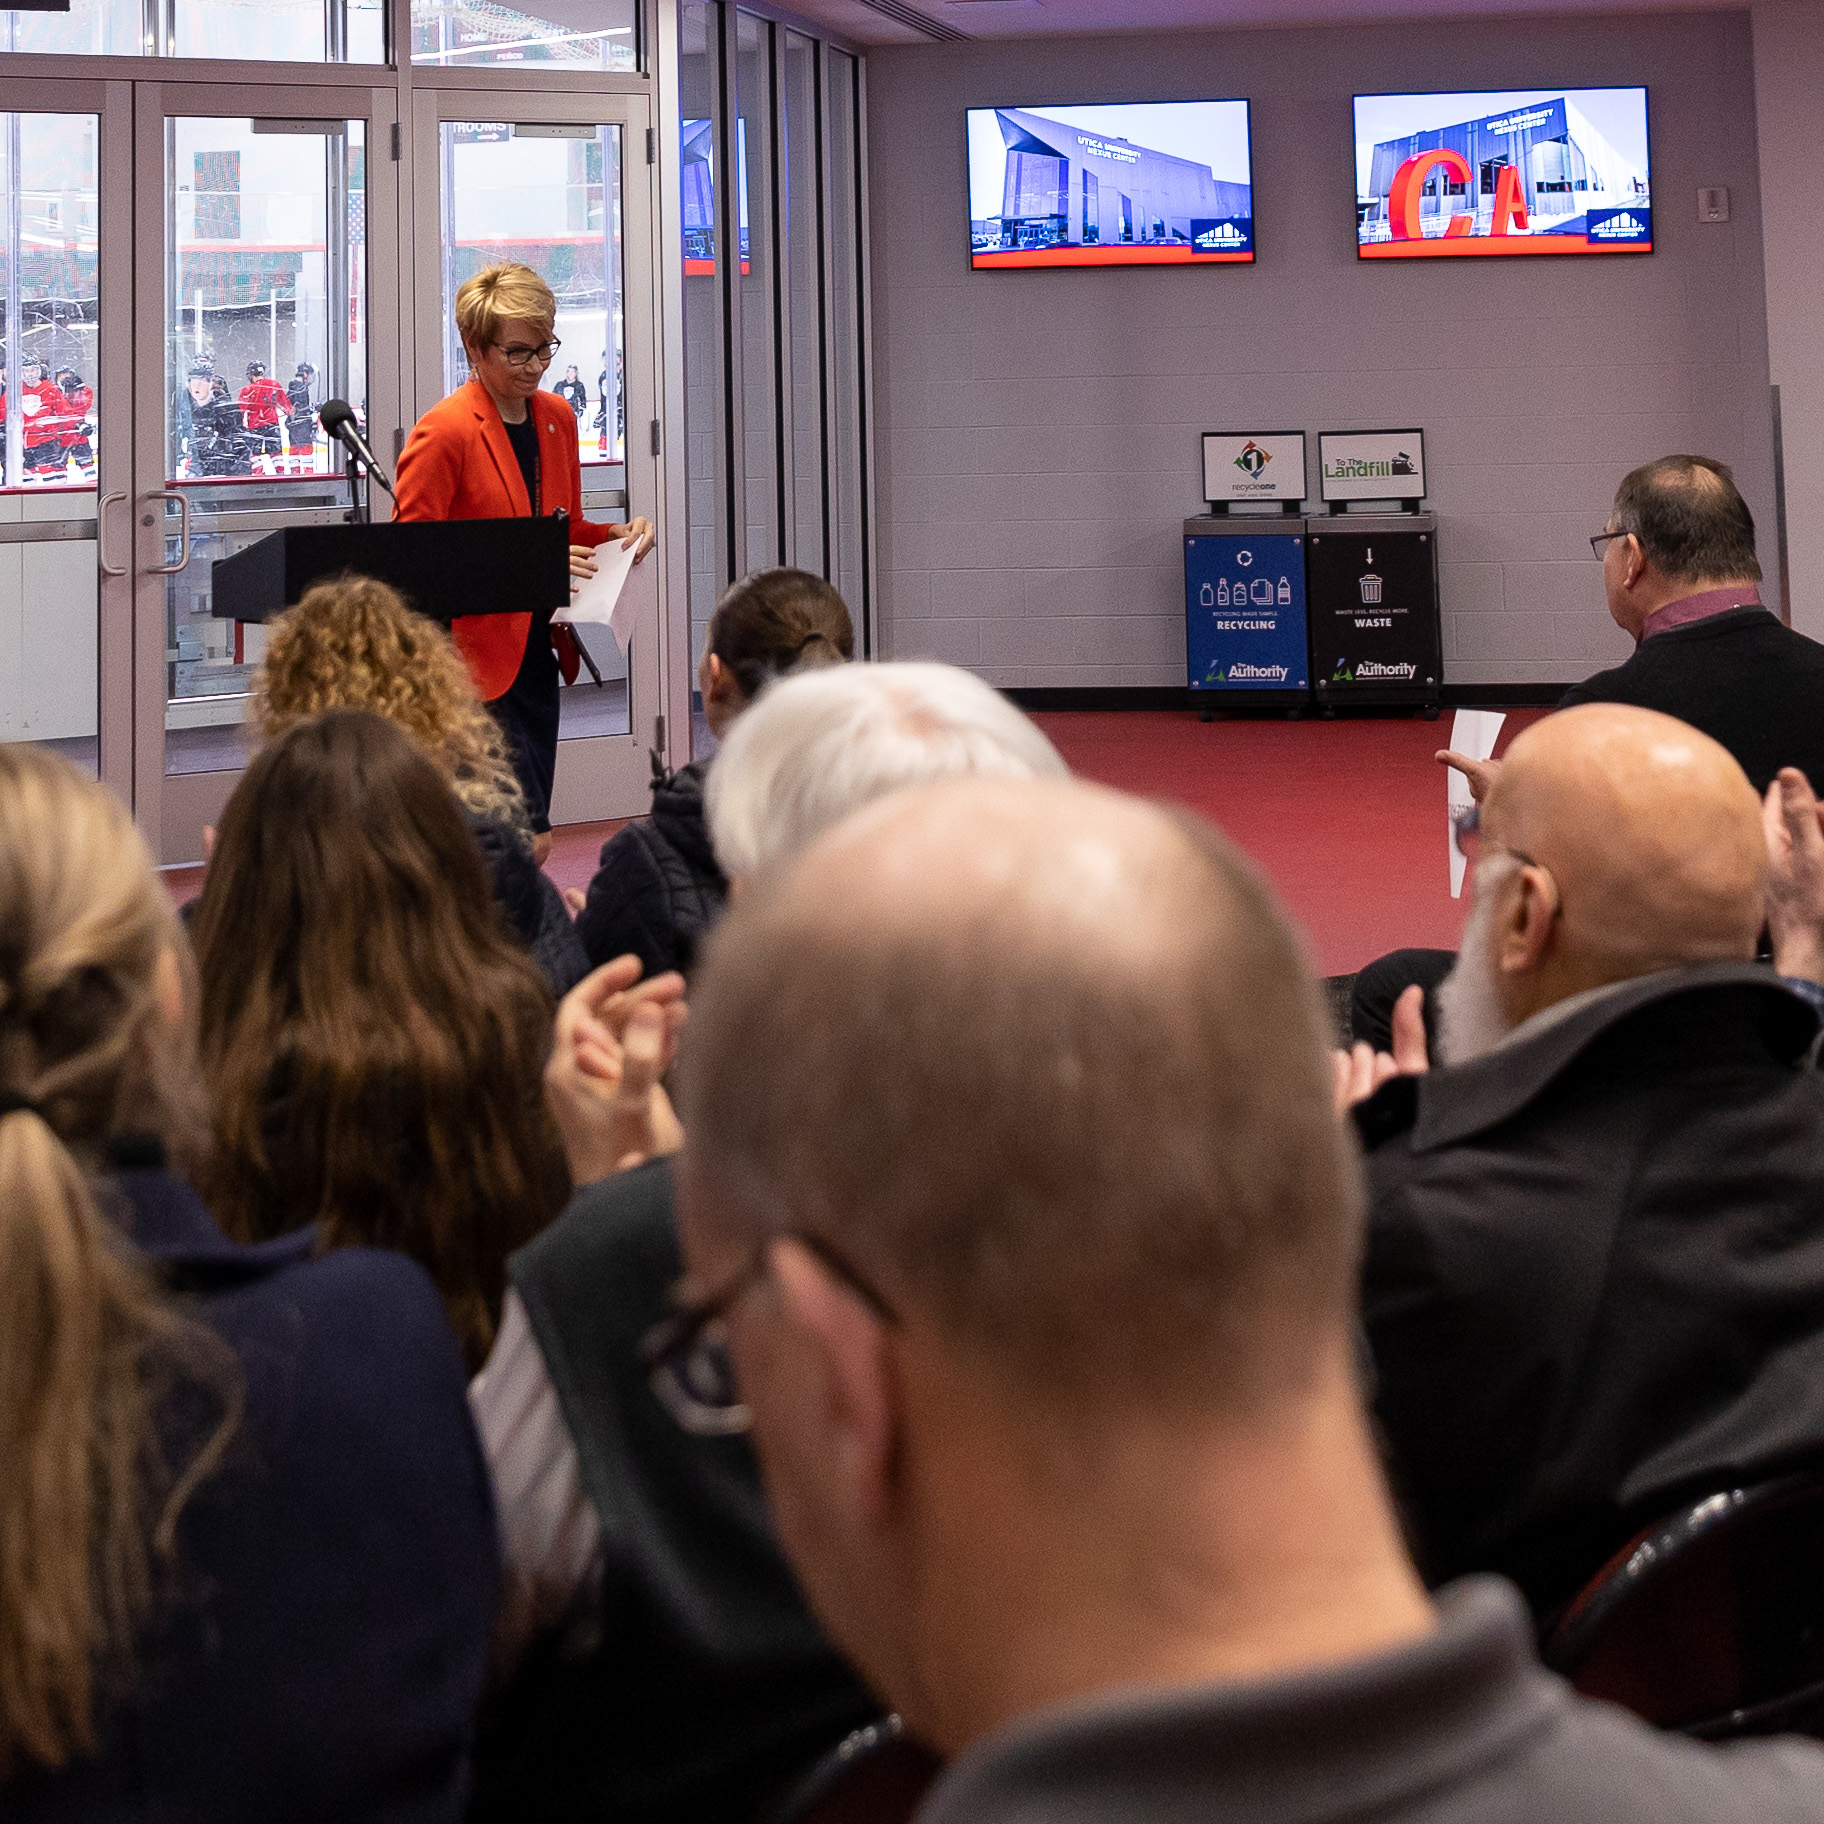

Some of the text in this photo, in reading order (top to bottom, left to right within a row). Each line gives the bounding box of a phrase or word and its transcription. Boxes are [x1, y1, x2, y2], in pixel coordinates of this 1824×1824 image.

[1077, 135, 1142, 159] UTICA UNIVERSITY
[1335, 458, 1364, 466] To The
[1325, 461, 1390, 478] Landfill
[1232, 482, 1276, 492] recycleone
[1216, 619, 1276, 630] RECYCLING
[1354, 617, 1393, 628] WASTE
[1228, 665, 1289, 681] Authority
[1356, 663, 1417, 680] Authority
